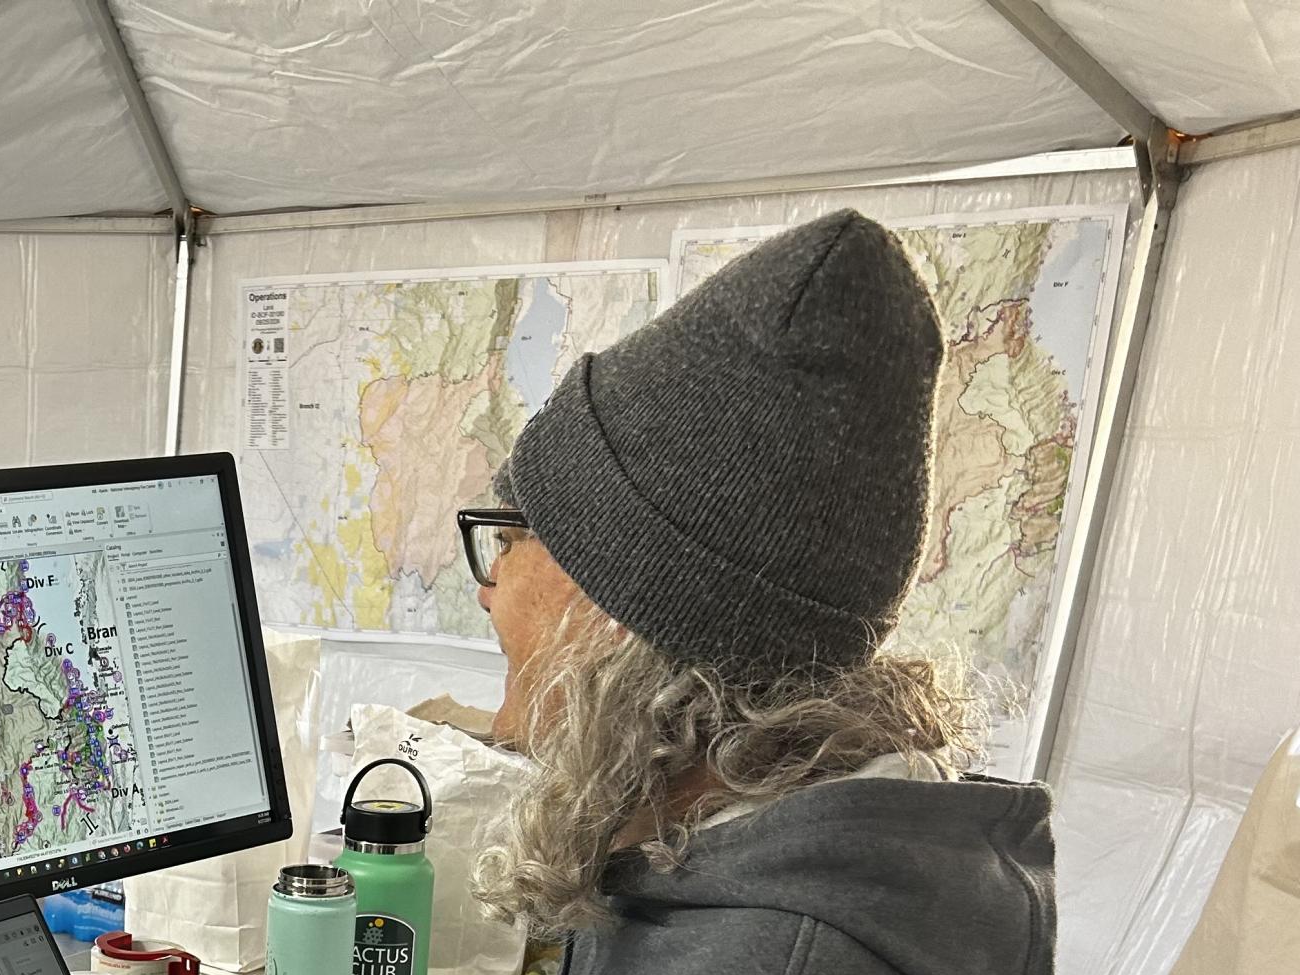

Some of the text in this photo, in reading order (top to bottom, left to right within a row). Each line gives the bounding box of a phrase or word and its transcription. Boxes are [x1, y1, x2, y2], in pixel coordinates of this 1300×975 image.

[249, 292, 286, 303] Operations
[26, 575, 54, 590] Div F
[88, 625, 118, 640] Bran
[45, 643, 74, 658] Div C
[398, 744, 418, 756] DURO
[112, 784, 140, 798] Div A
[52, 876, 78, 890] DELL
[353, 946, 408, 964] ACTUS
